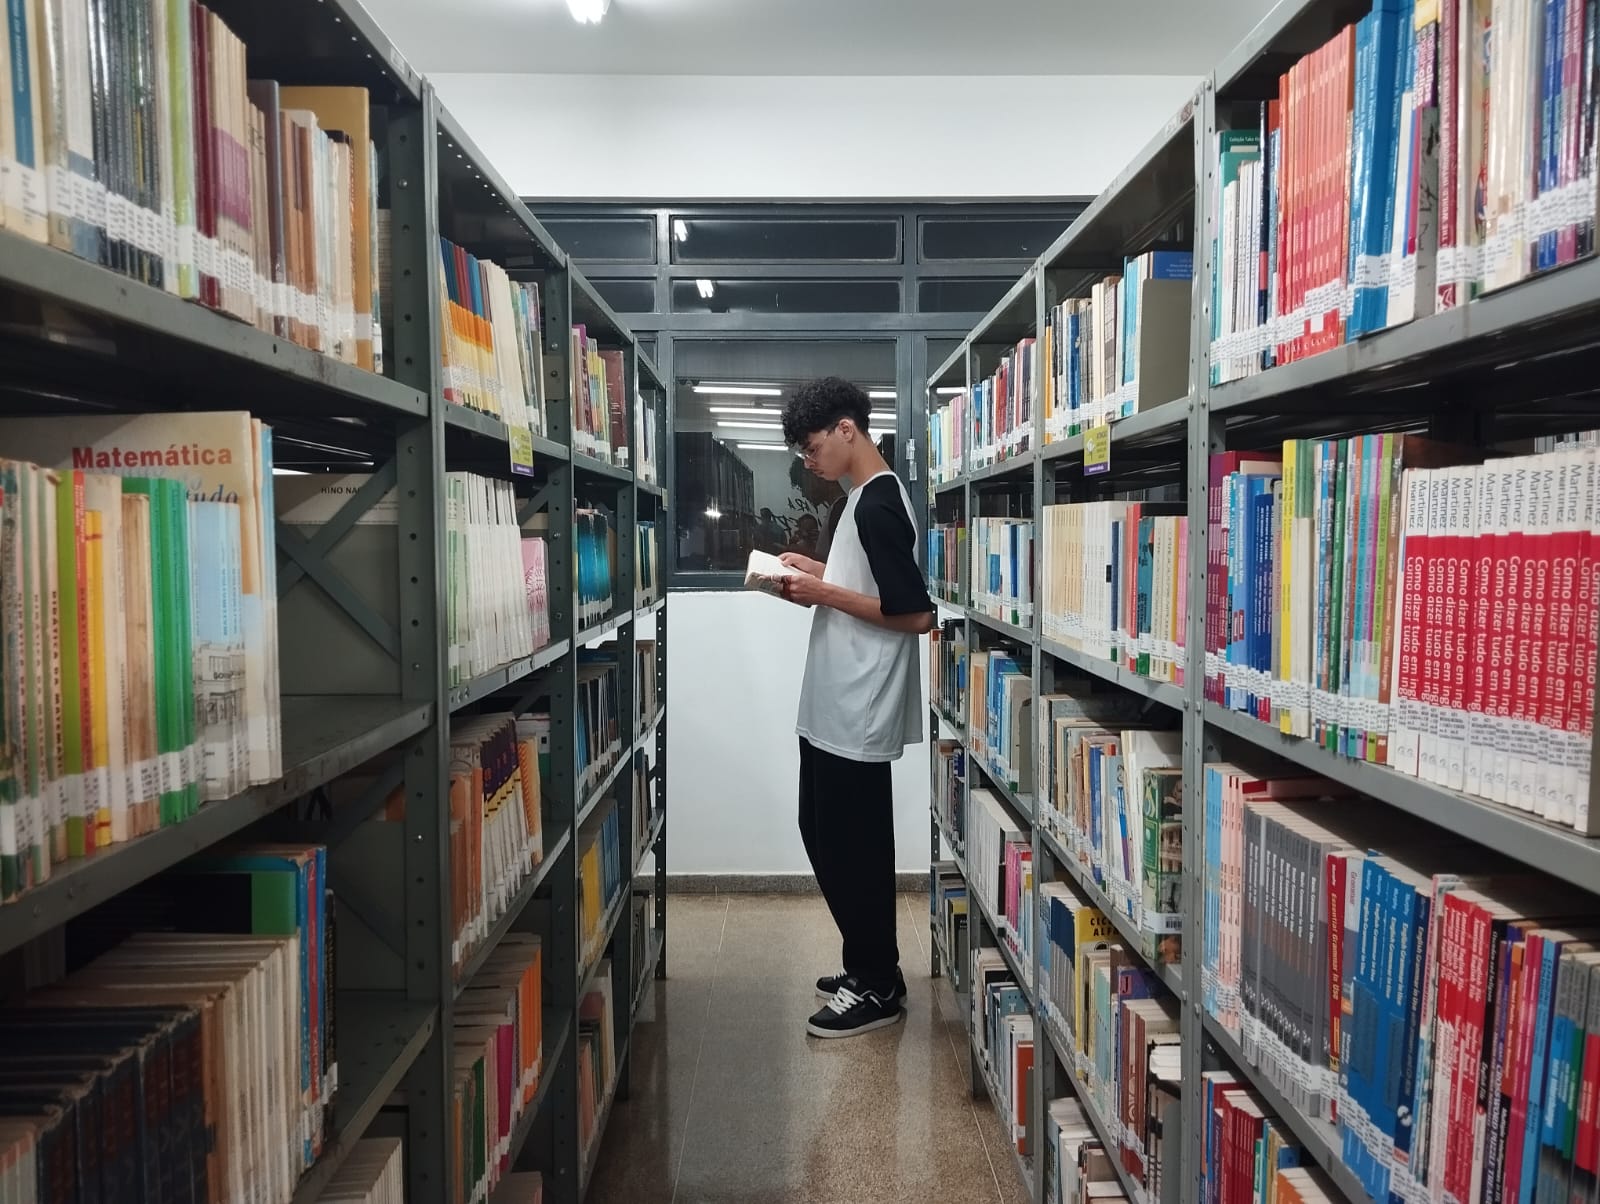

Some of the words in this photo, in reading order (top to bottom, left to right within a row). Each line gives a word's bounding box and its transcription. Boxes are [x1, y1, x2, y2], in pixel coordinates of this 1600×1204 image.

[72, 444, 232, 469] Matemática
[1417, 480, 1427, 527] Martinez
[1450, 478, 1460, 529] Martinez
[1463, 478, 1472, 528] Martinez
[1485, 473, 1496, 525] Martinez
[1500, 474, 1511, 527] Martinez
[1514, 469, 1525, 523] Martinez
[1529, 471, 1541, 526] Martinez
[1541, 470, 1553, 526] Martinez
[1568, 464, 1582, 522] Martinez
[1414, 557, 1424, 590] Como
[1446, 558, 1457, 593] Como
[1460, 560, 1470, 595] Como
[1481, 557, 1491, 594] Como
[1495, 560, 1507, 597] Como
[1509, 556, 1520, 594] Como
[1523, 560, 1535, 598] Como
[1536, 560, 1548, 599] Como
[1562, 558, 1576, 599] Como
[1413, 594, 1422, 621] dizer
[1446, 597, 1455, 625] dizer
[1458, 599, 1468, 629] dizer
[1479, 598, 1489, 629] dizer
[1494, 601, 1504, 632] dizer
[1507, 599, 1518, 629] dizer
[1521, 603, 1532, 634] dizer
[1534, 604, 1546, 636] dizer
[1560, 603, 1573, 638] dizer
[1412, 626, 1421, 653] tudo
[1444, 631, 1453, 659] tudo
[1457, 633, 1466, 661] tudo
[1477, 634, 1487, 663] tudo
[1492, 637, 1503, 667] tudo
[1505, 635, 1515, 665] tudo
[1519, 639, 1530, 670] tudo
[1411, 656, 1418, 675] em
[1443, 662, 1450, 681] em
[1532, 641, 1543, 672] tudo
[1556, 643, 1570, 675] tudo
[1456, 665, 1463, 685] em
[1476, 666, 1484, 687] em
[1491, 671, 1498, 692] em
[1503, 670, 1510, 690] em
[1517, 675, 1525, 696] em
[1530, 677, 1538, 698] em
[1555, 680, 1564, 701] em
[1331, 893, 1339, 932] Essential
[1331, 934, 1340, 971] Grammar
[1416, 926, 1424, 953] English
[1333, 984, 1341, 1001] Use
[1493, 1064, 1504, 1128] CROSSWORD
[1488, 1131, 1499, 1166] PUZZLE
